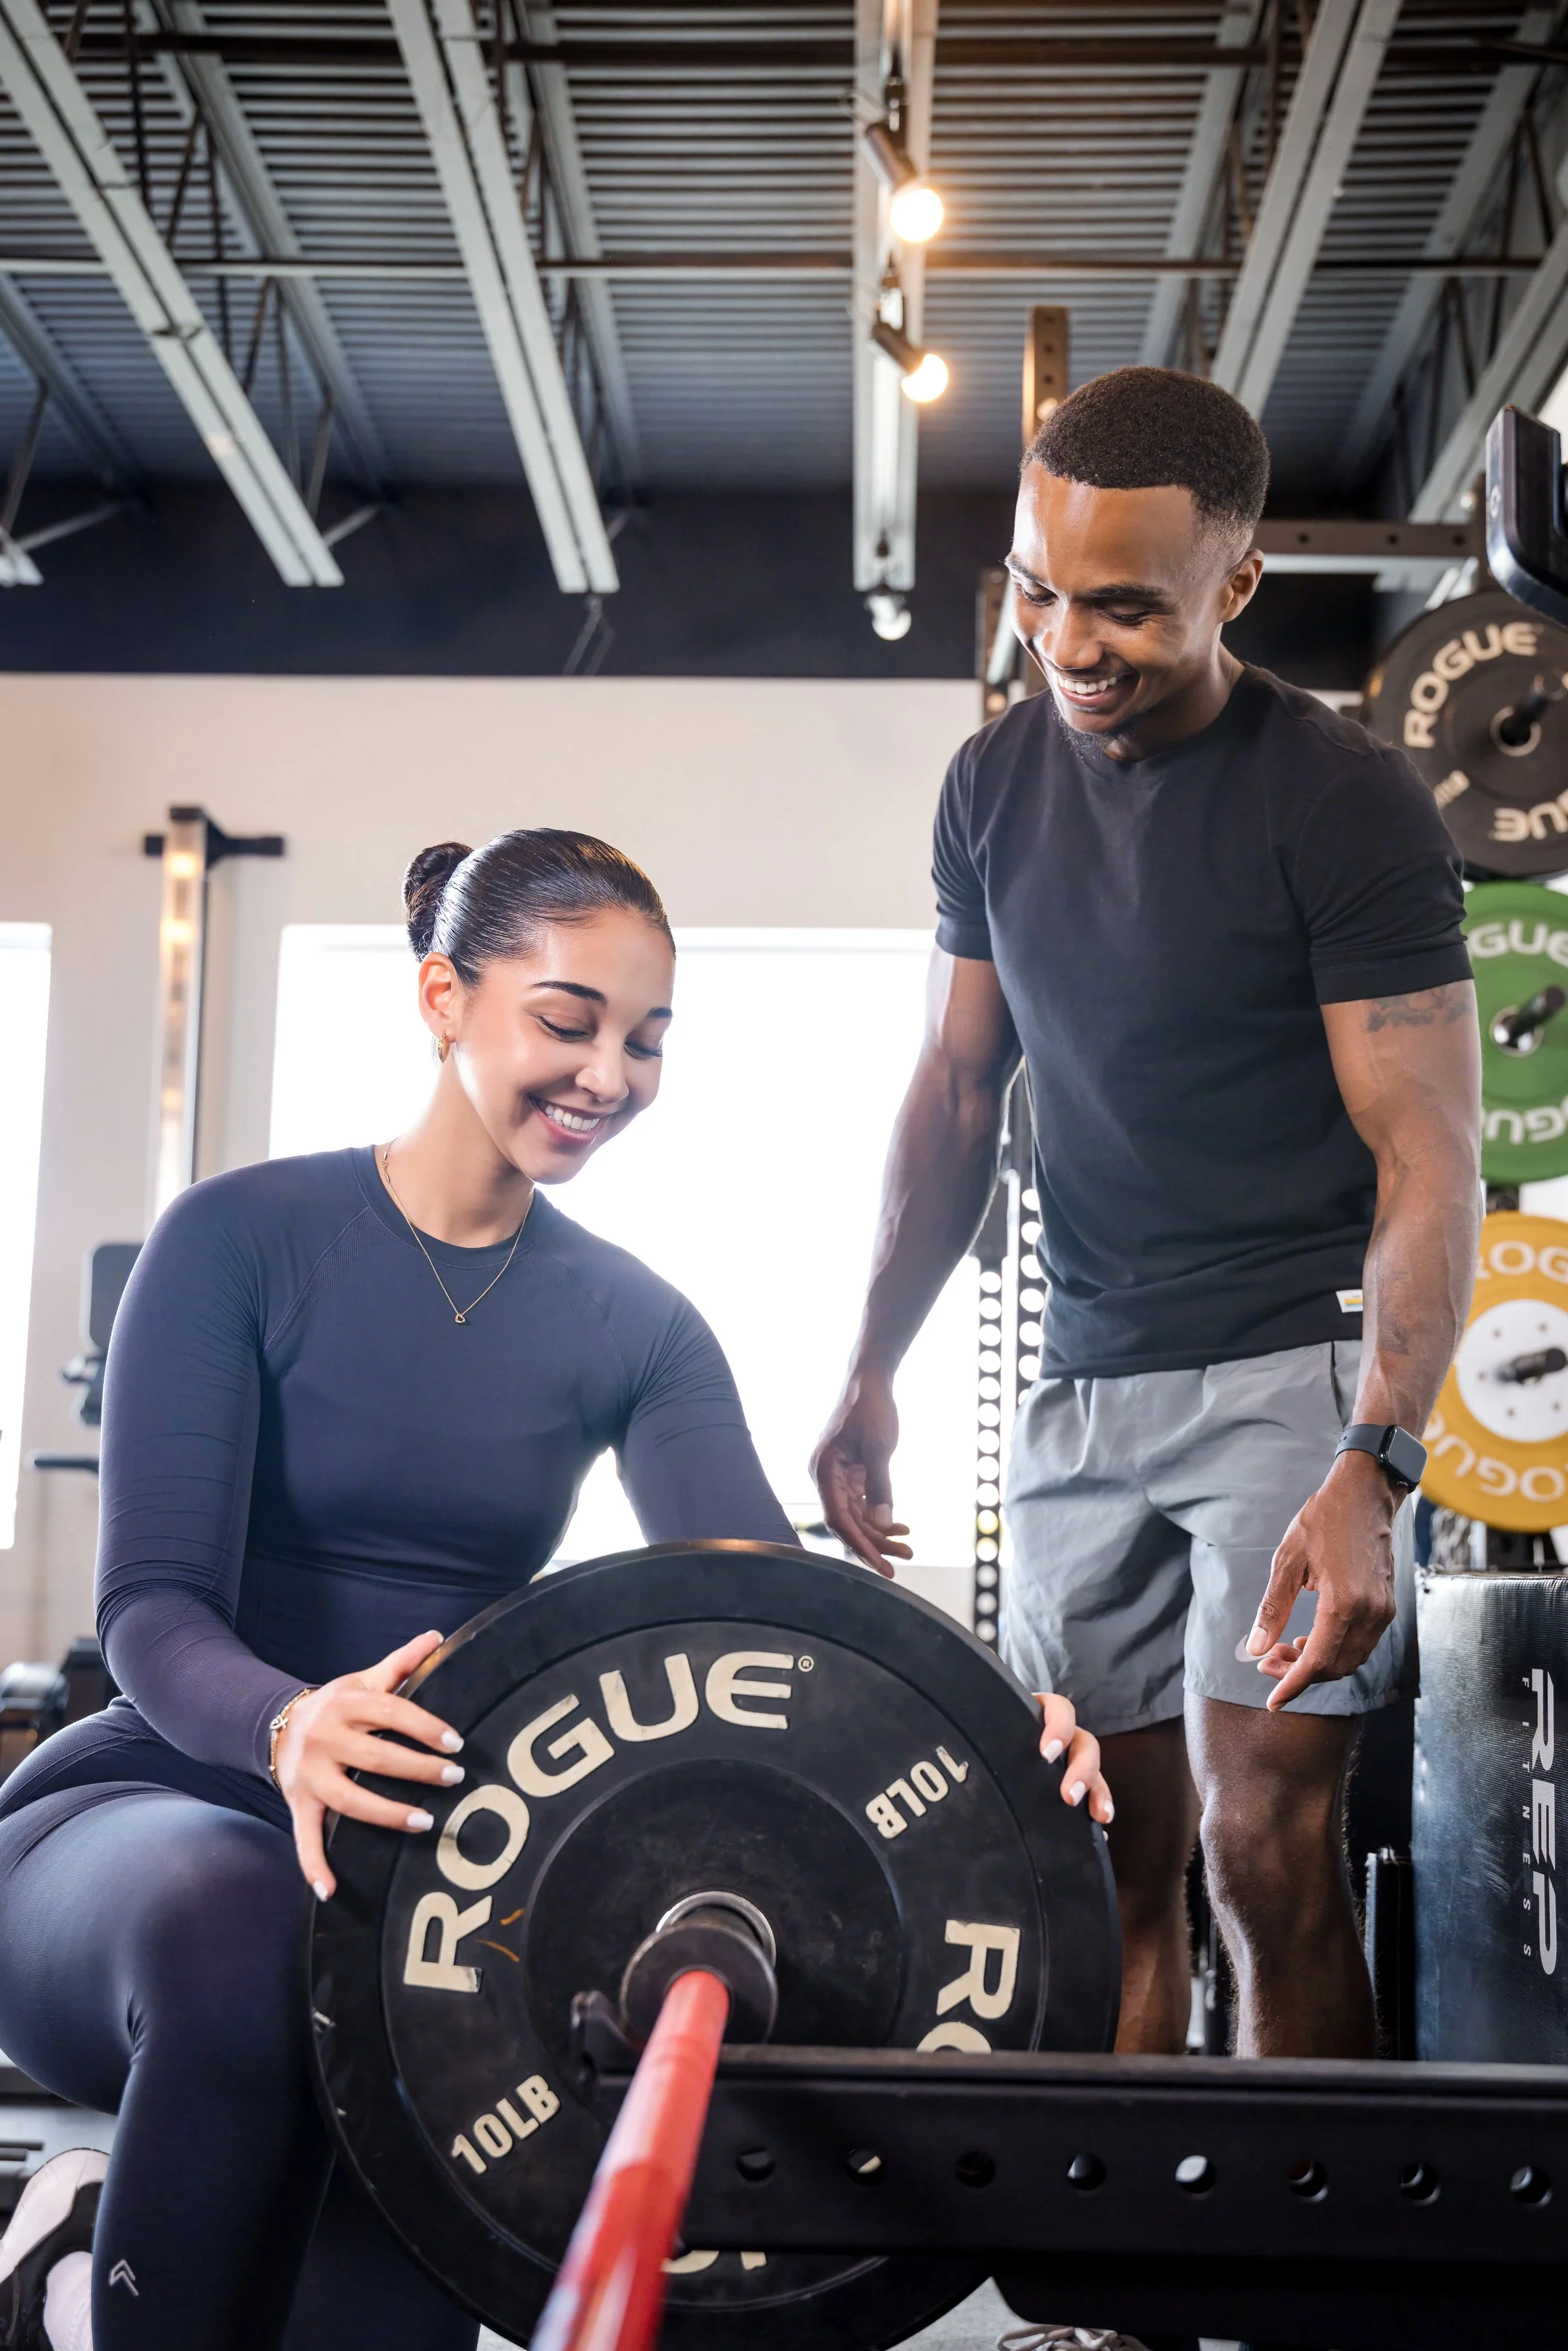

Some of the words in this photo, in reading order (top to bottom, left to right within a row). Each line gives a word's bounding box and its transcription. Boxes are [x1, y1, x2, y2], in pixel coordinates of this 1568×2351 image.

[1404, 621, 1538, 748] ROGUE
[865, 1746, 969, 1839] 10LB
[1532, 1669, 1557, 1975] REP
[451, 2074, 561, 2175] 10LB
